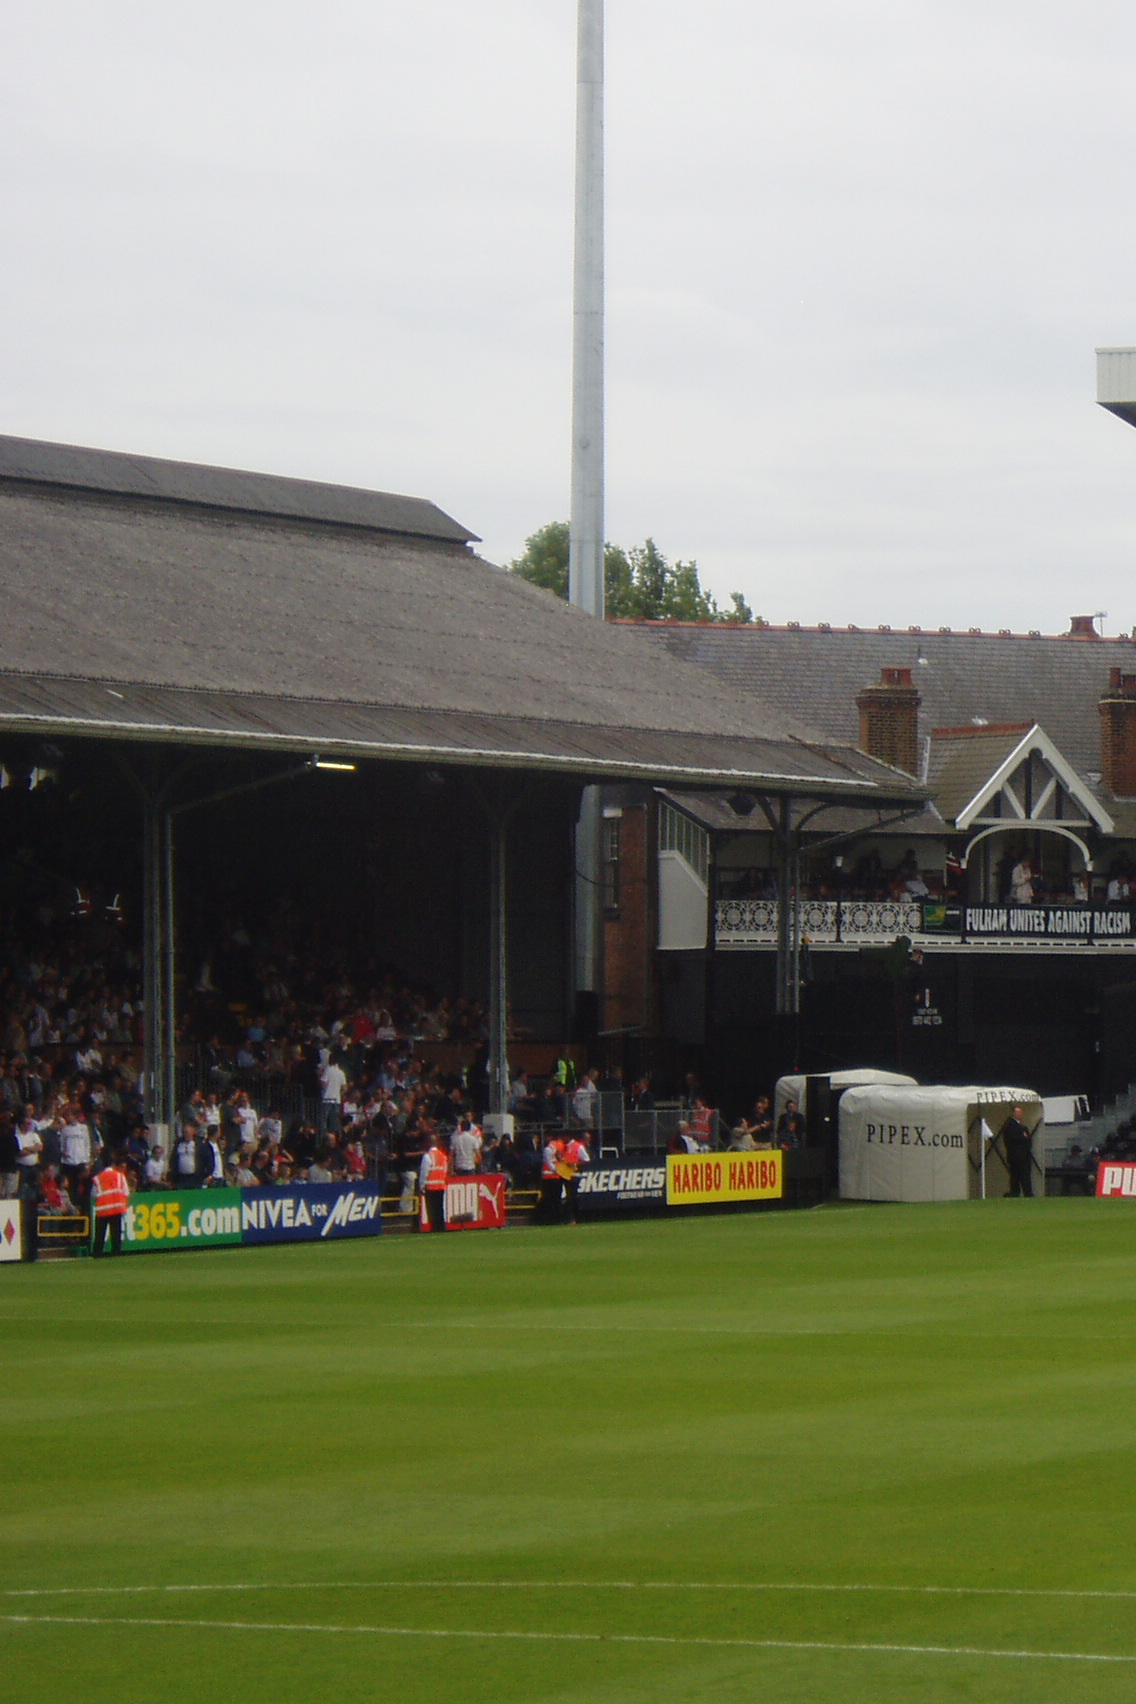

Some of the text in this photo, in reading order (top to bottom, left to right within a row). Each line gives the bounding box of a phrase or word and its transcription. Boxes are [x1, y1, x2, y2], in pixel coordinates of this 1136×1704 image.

[966, 908, 1131, 935] FULHAM UNITES AGAINST RACISM
[976, 1091, 1040, 1103] PIPEX.com
[867, 1123, 965, 1148] PIPEX.com
[572, 1167, 666, 1193] SKECHERS
[673, 1160, 777, 1194] HARIBO HARIBO
[104, 1202, 240, 1241] t365.com
[242, 1199, 312, 1231] NIVEA
[312, 1203, 328, 1217] FOR
